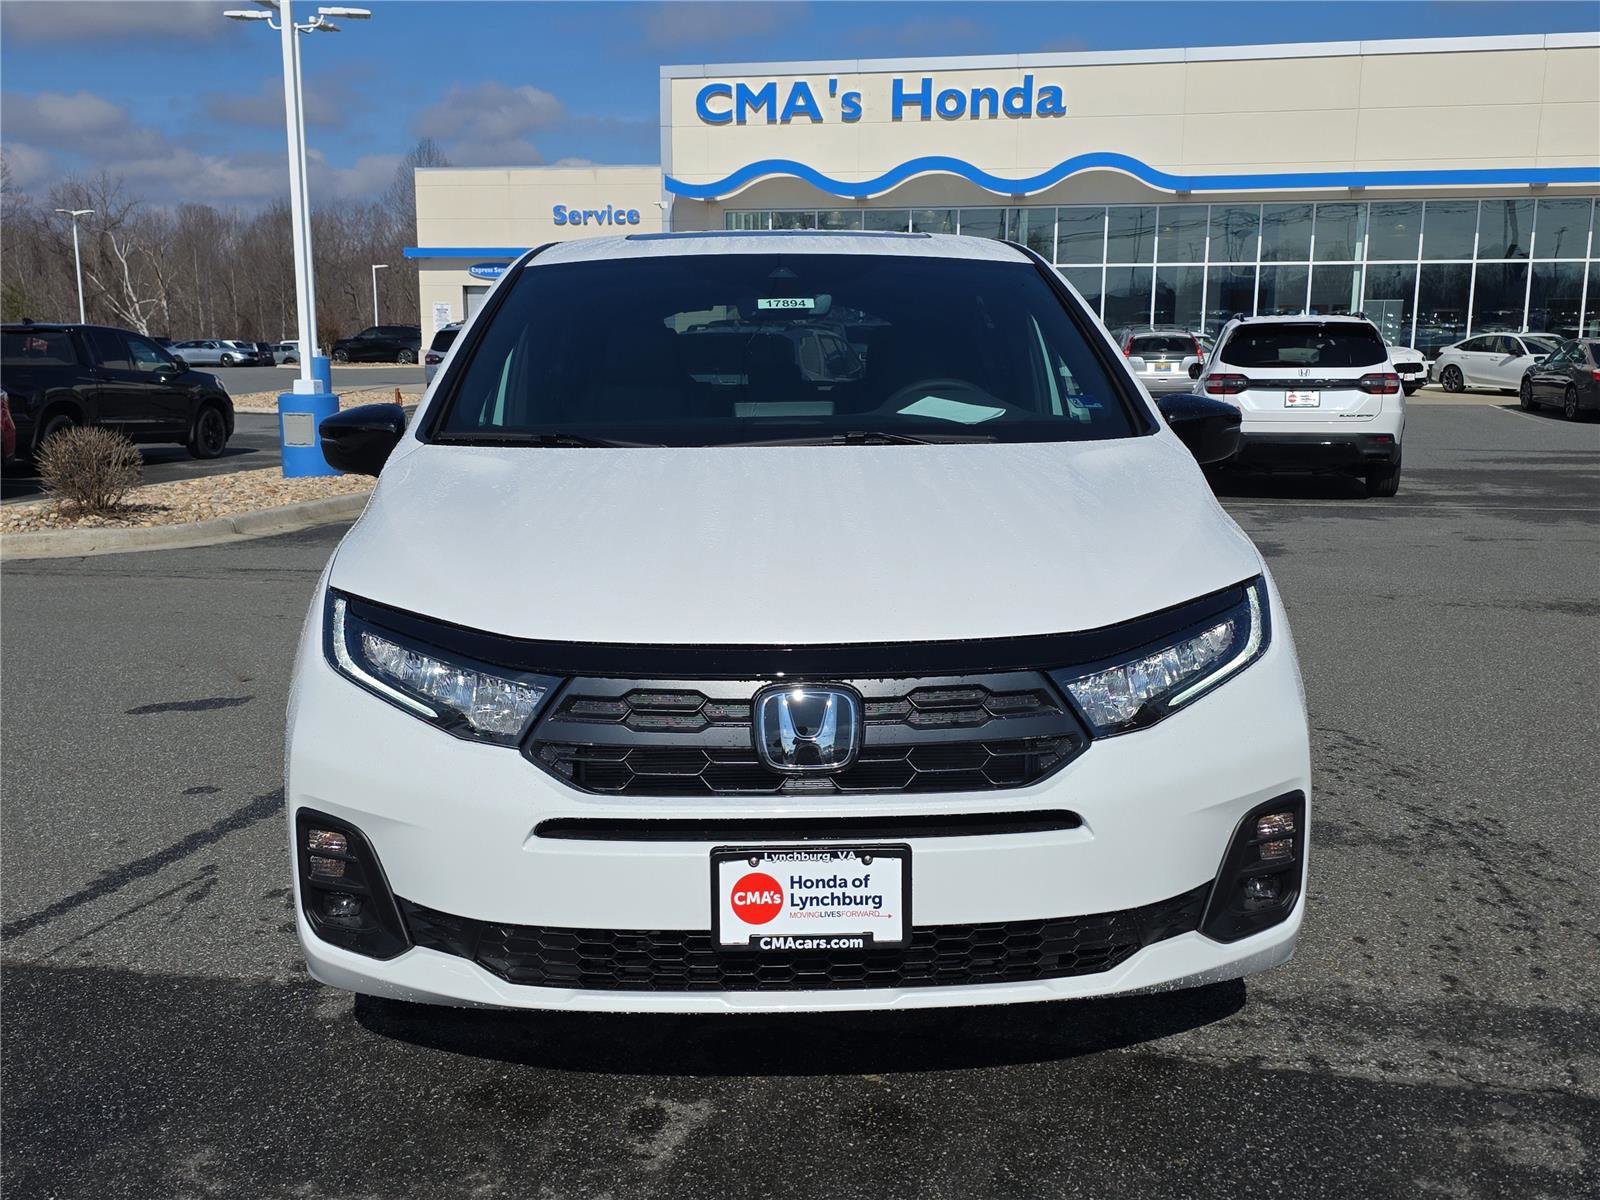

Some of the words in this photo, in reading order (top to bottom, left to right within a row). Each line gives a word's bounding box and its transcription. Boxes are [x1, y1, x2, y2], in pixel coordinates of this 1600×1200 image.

[695, 78, 862, 126] CMA's
[891, 75, 1067, 122] Honda
[552, 204, 640, 226] Service
[763, 852, 834, 863] Lynchburg,
[837, 851, 857, 861] VA
[790, 875, 848, 890] Honda
[851, 874, 870, 889] of
[733, 891, 782, 906] CMA's
[790, 892, 883, 910] Lynchburg
[759, 936, 864, 950] CMAcars.com
